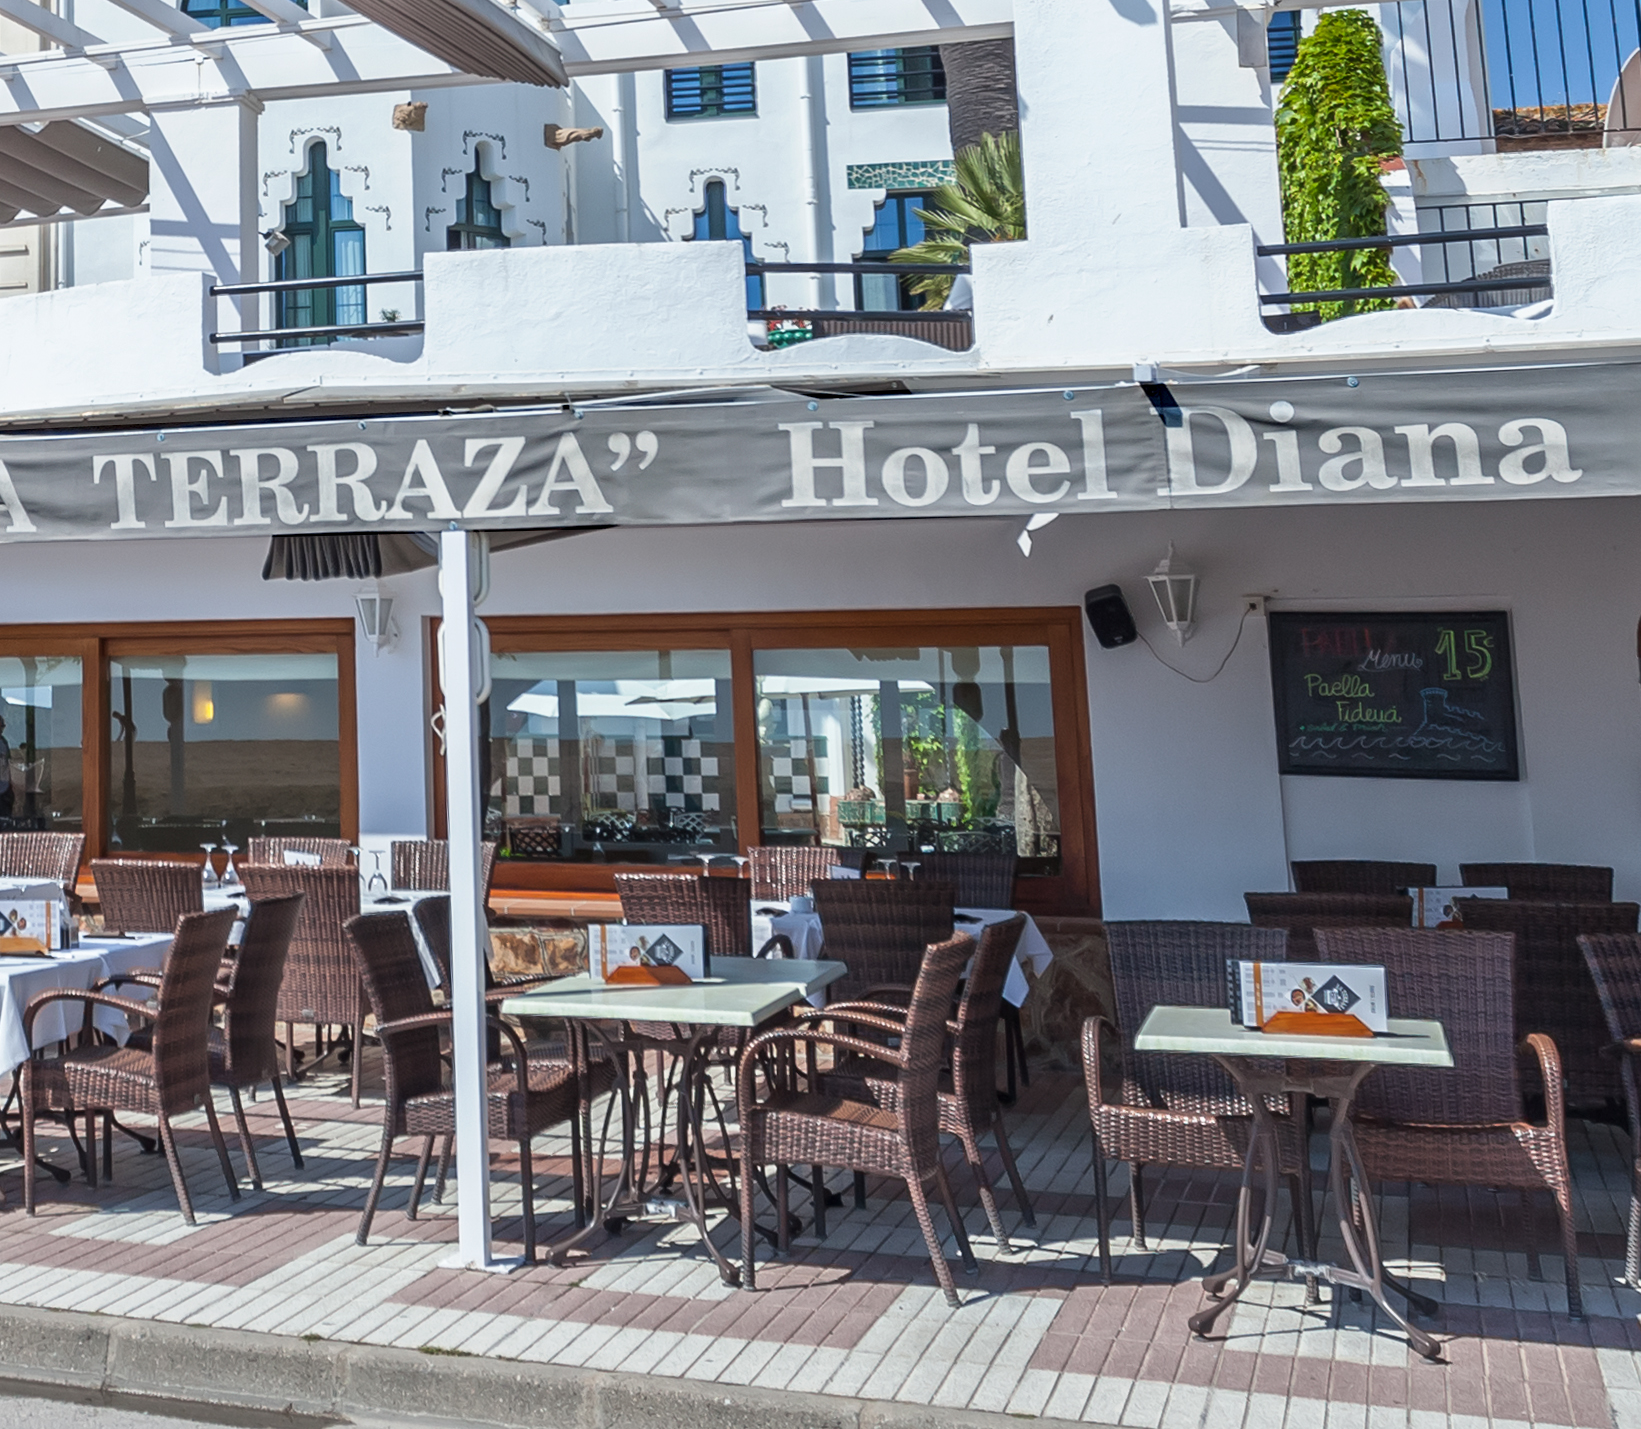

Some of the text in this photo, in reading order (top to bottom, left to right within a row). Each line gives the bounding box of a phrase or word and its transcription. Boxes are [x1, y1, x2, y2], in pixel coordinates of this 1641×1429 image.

[777, 400, 1584, 508] Hotel Diana
[1303, 674, 1375, 698] Paella
